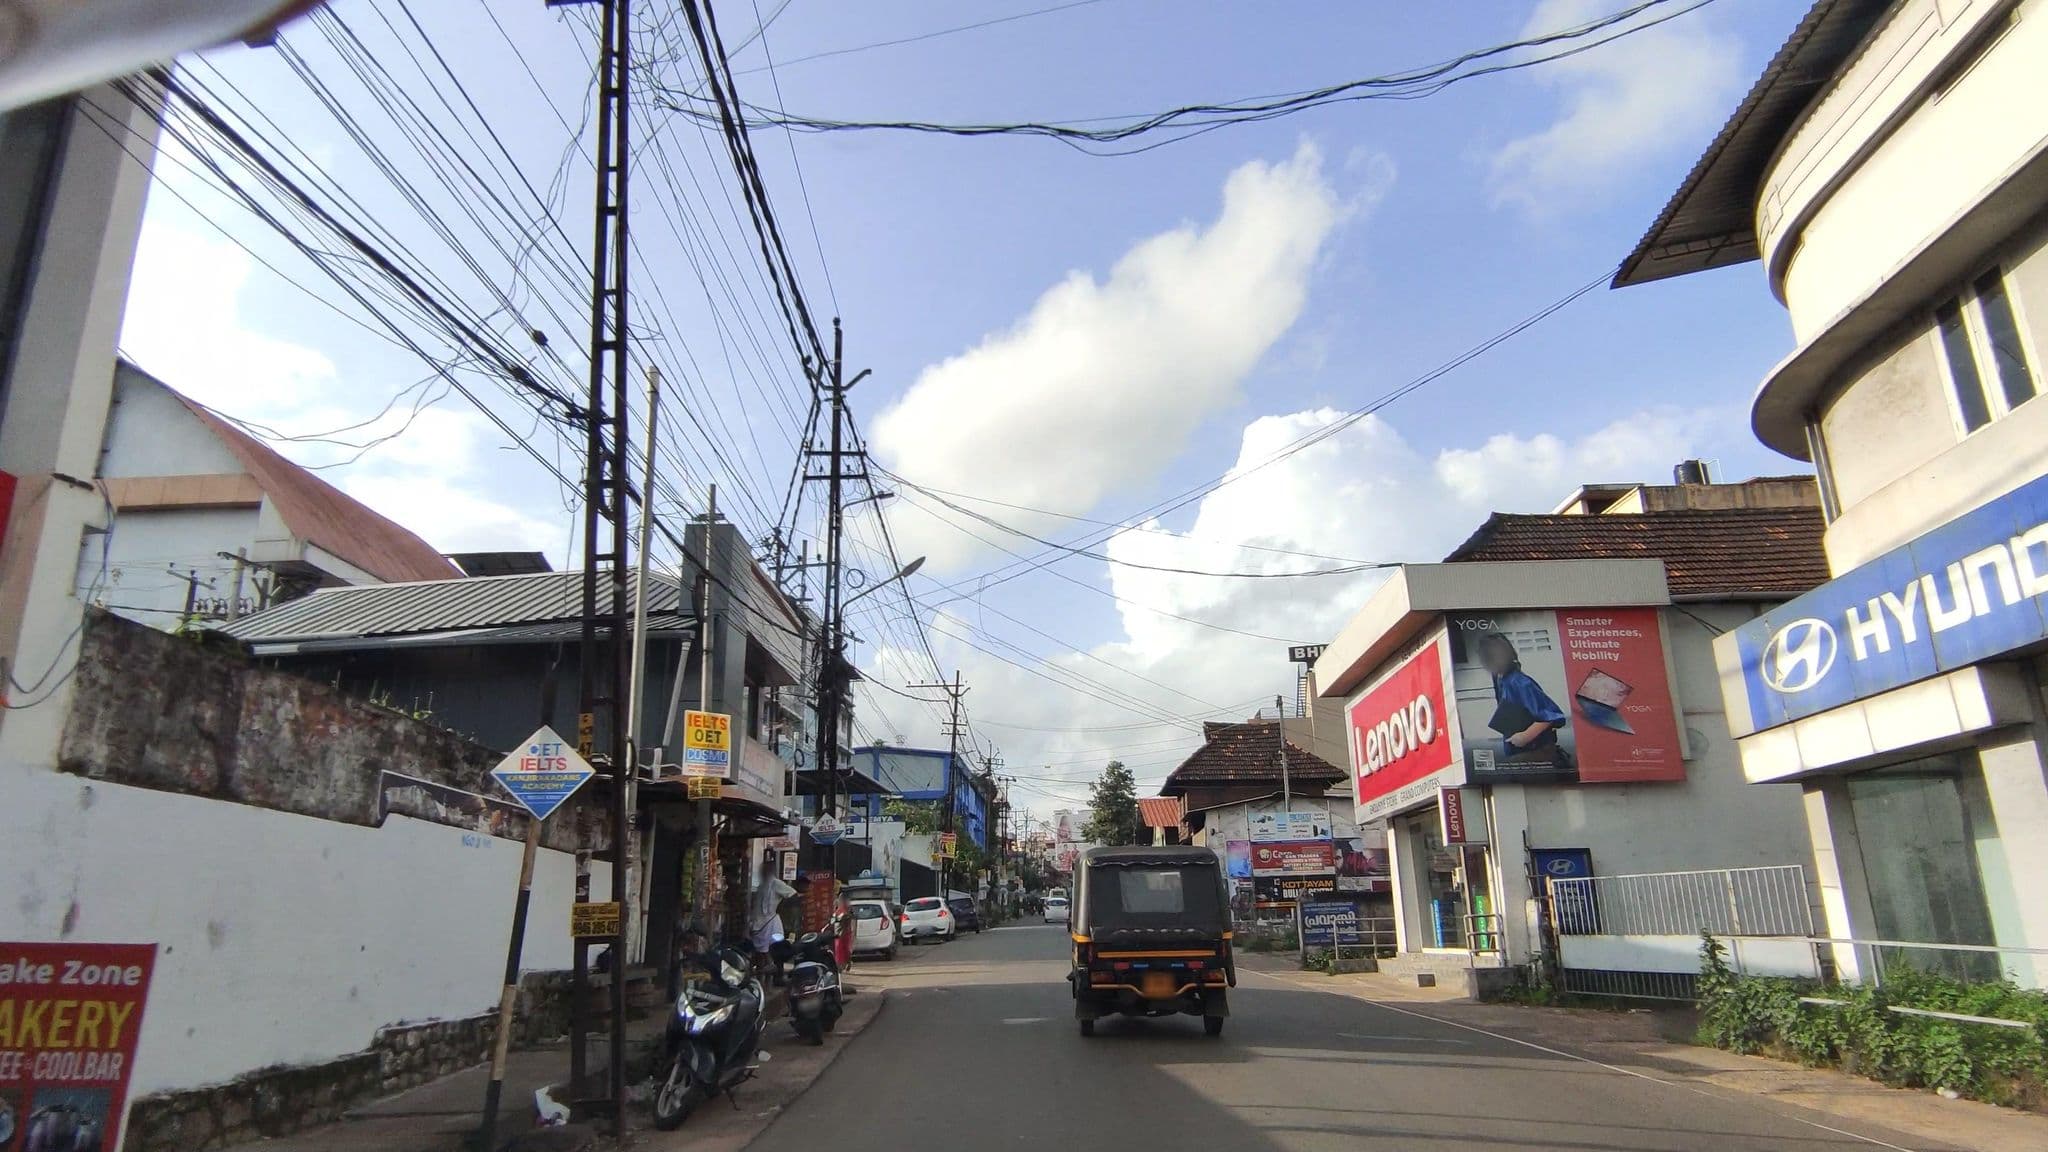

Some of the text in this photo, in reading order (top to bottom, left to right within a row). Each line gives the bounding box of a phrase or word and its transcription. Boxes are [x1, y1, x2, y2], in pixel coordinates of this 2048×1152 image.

[1456, 619, 1500, 631] YOGA
[1566, 617, 1613, 627] Smarter
[1568, 628, 1642, 639] Experiences,
[1570, 639, 1620, 649] Ultimate
[1572, 650, 1620, 662] Mobility
[1625, 705, 1653, 713] YOGA
[688, 714, 728, 730] IELTS
[694, 729, 722, 744] OET
[1354, 695, 1438, 778] Lenovo
[520, 757, 567, 771] IELTS
[1447, 793, 1461, 839] Lenovo
[1282, 880, 1334, 889] KOTTAYAM
[60, 960, 142, 986] Zone
[33, 1052, 124, 1081] COOLBAR
